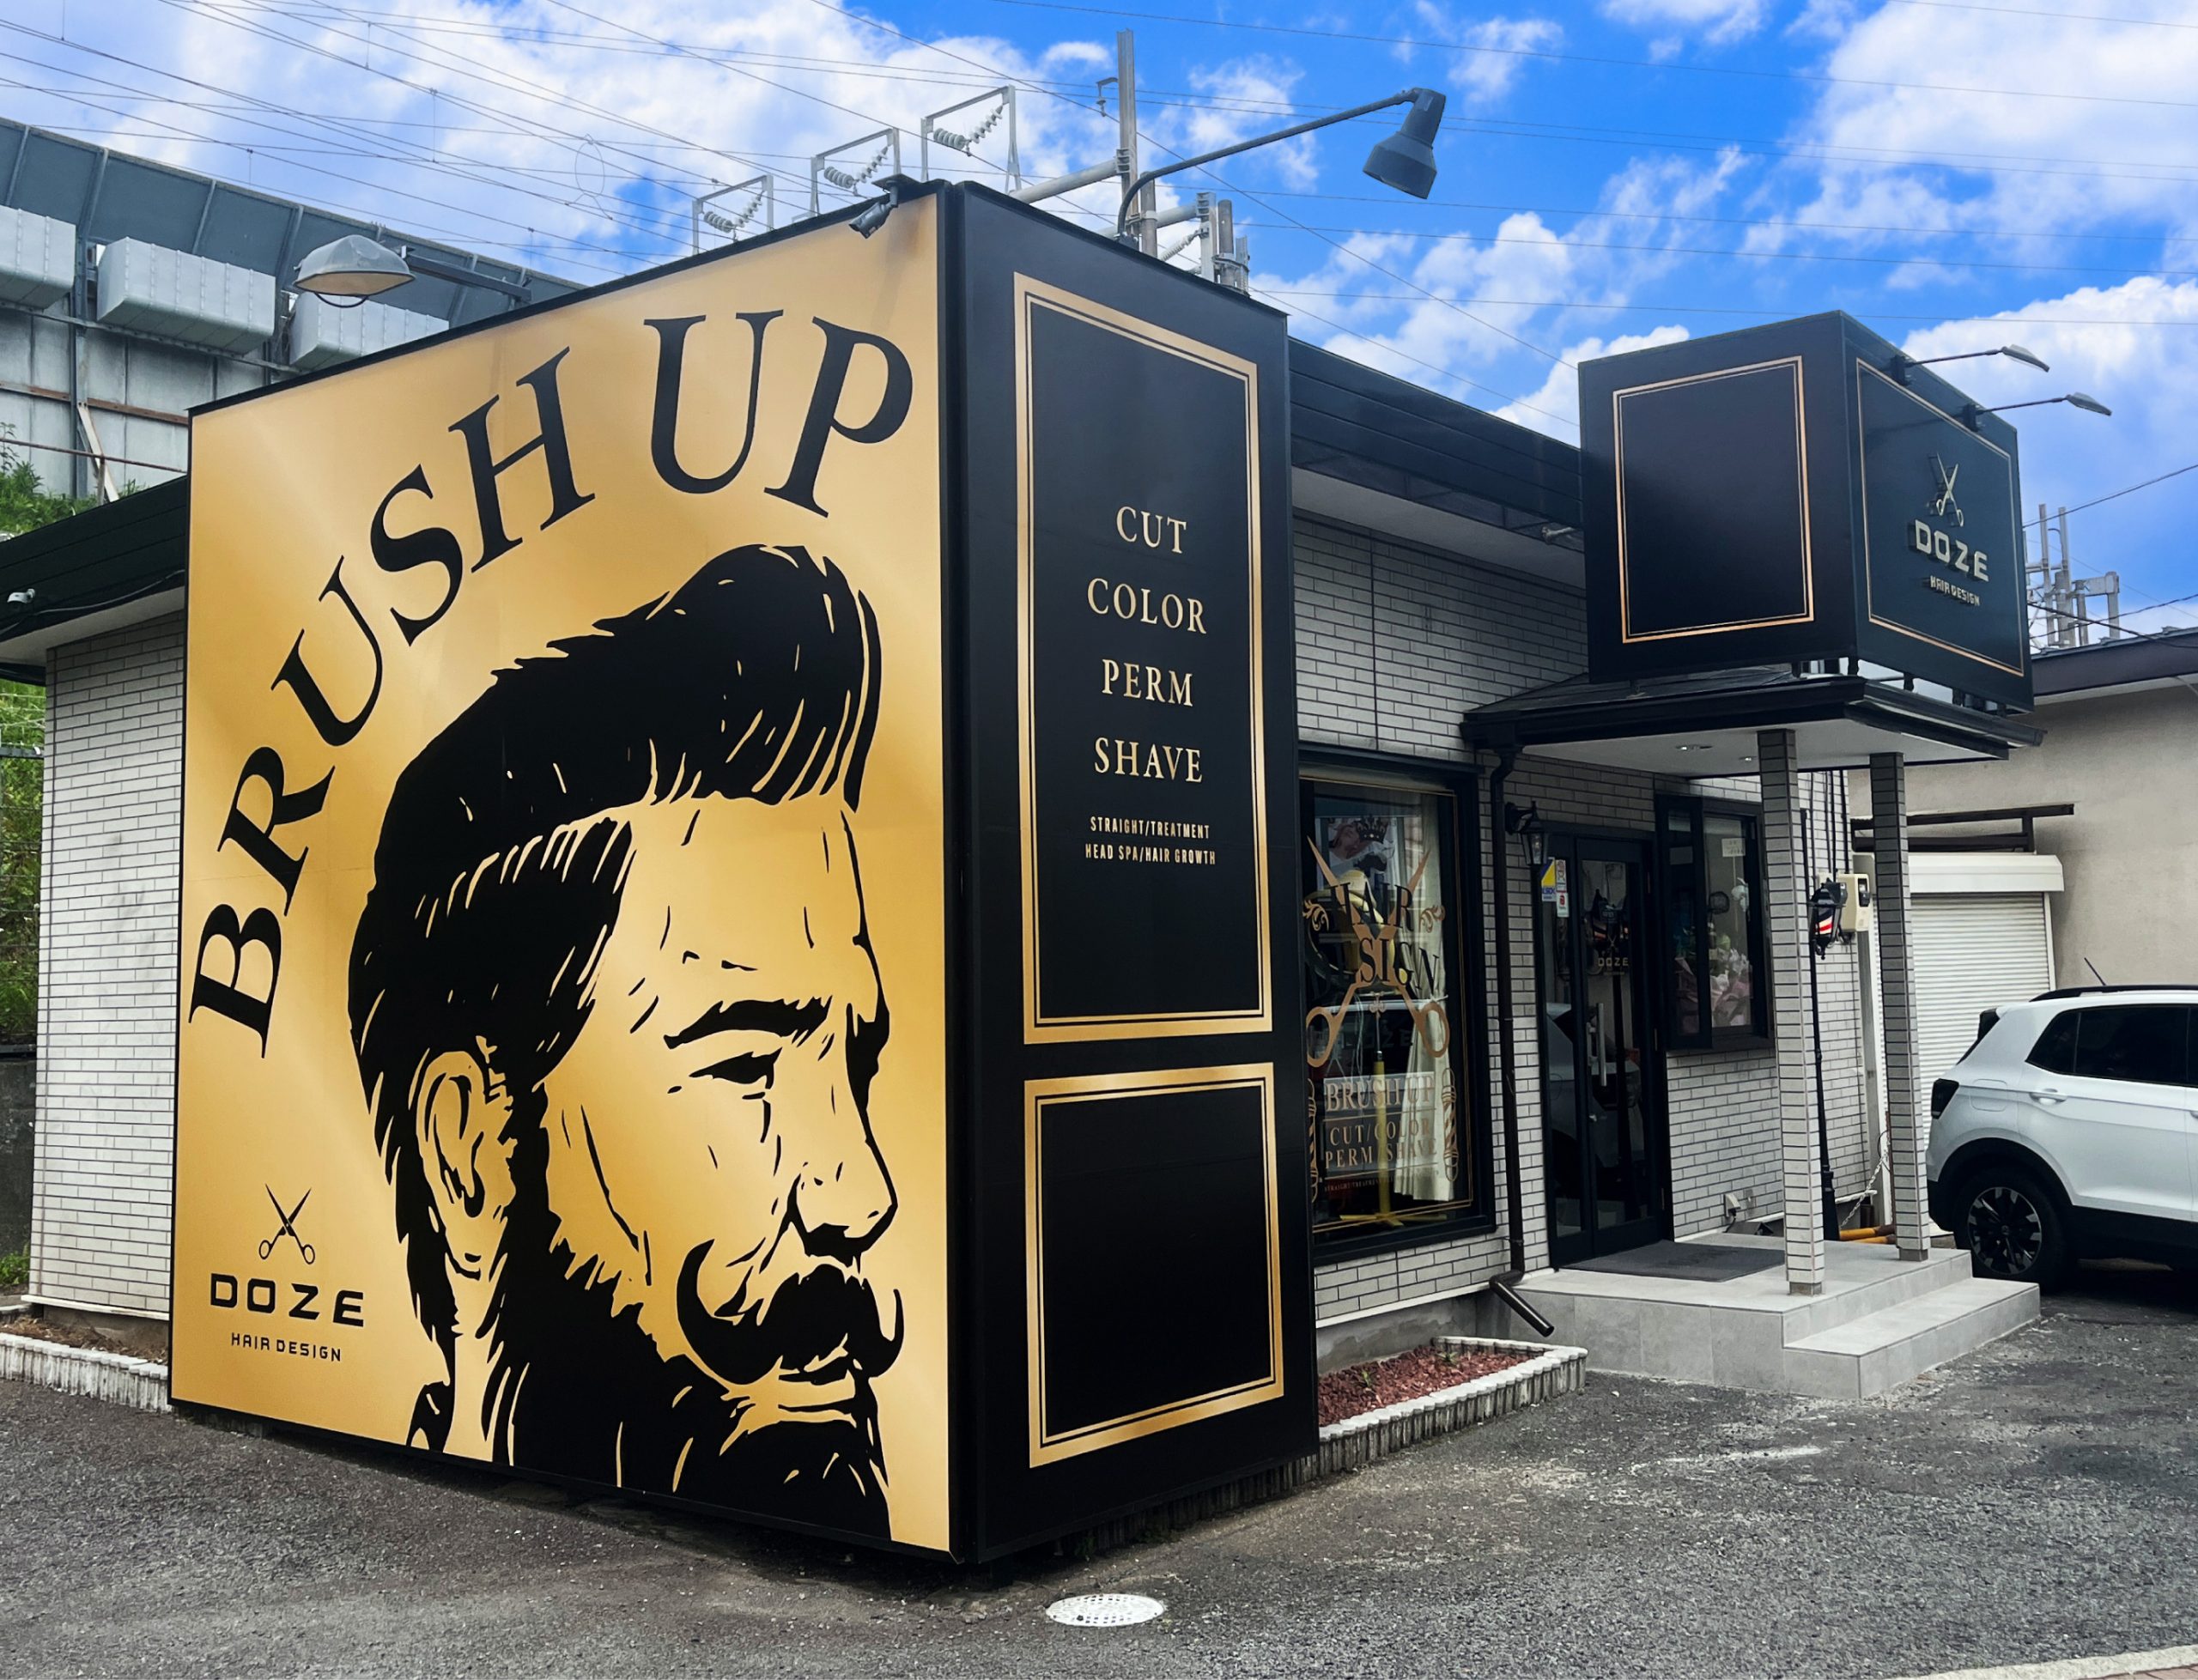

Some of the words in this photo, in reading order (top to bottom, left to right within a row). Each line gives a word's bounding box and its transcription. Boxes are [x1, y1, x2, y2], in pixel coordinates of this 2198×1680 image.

[1116, 506, 1187, 554] CUT
[1915, 519, 1989, 582] DOZE
[1087, 577, 1207, 634] COLOR
[1930, 575, 1950, 594] HAIR
[1951, 585, 1980, 606] DESIGN
[189, 346, 595, 1058] BRUSH
[642, 310, 914, 519] UP
[1102, 658, 1193, 707] PERM
[1094, 737, 1203, 783] SHAVE
[1090, 816, 1210, 840] STRAIGHT/TREATMENT
[1084, 843, 1114, 860] HEAD
[1118, 845, 1170, 864] SPA/HAIR
[1175, 848, 1216, 865] GROWTH
[1328, 882, 1414, 932] HAIR
[1598, 956, 1629, 967] DOZE
[1326, 1077, 1401, 1112] BRUSH
[1406, 1075, 1434, 1105] UP
[210, 1272, 364, 1327] DOZE
[231, 1331, 270, 1351] HAIR
[276, 1338, 342, 1362] DESIGN
